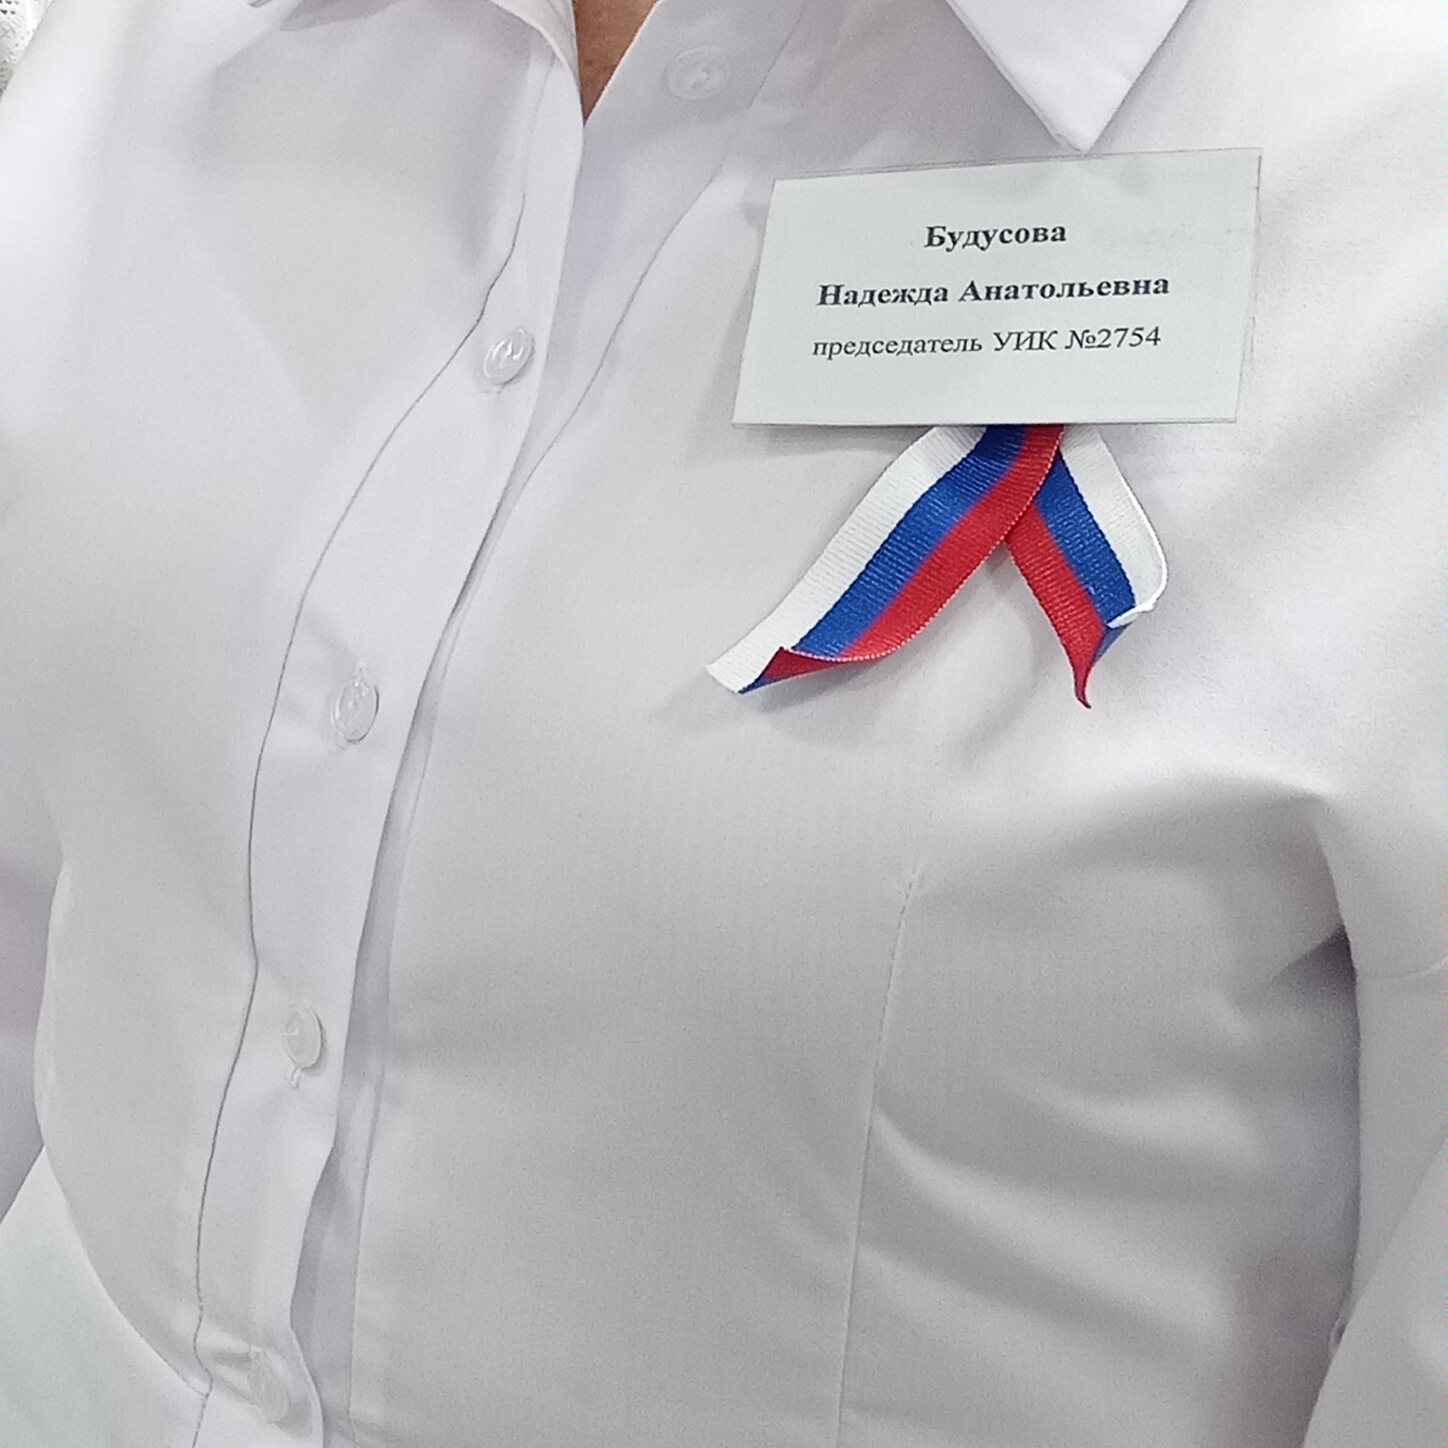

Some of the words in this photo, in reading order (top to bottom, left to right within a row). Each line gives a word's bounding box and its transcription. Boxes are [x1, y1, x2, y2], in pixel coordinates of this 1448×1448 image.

[923, 225, 1067, 252] Будусова
[816, 283, 949, 307] Надежда
[958, 278, 1170, 302] Анатольевна
[812, 336, 983, 360] председатель
[993, 330, 1059, 352] УИК
[1064, 326, 1161, 351] №2754
